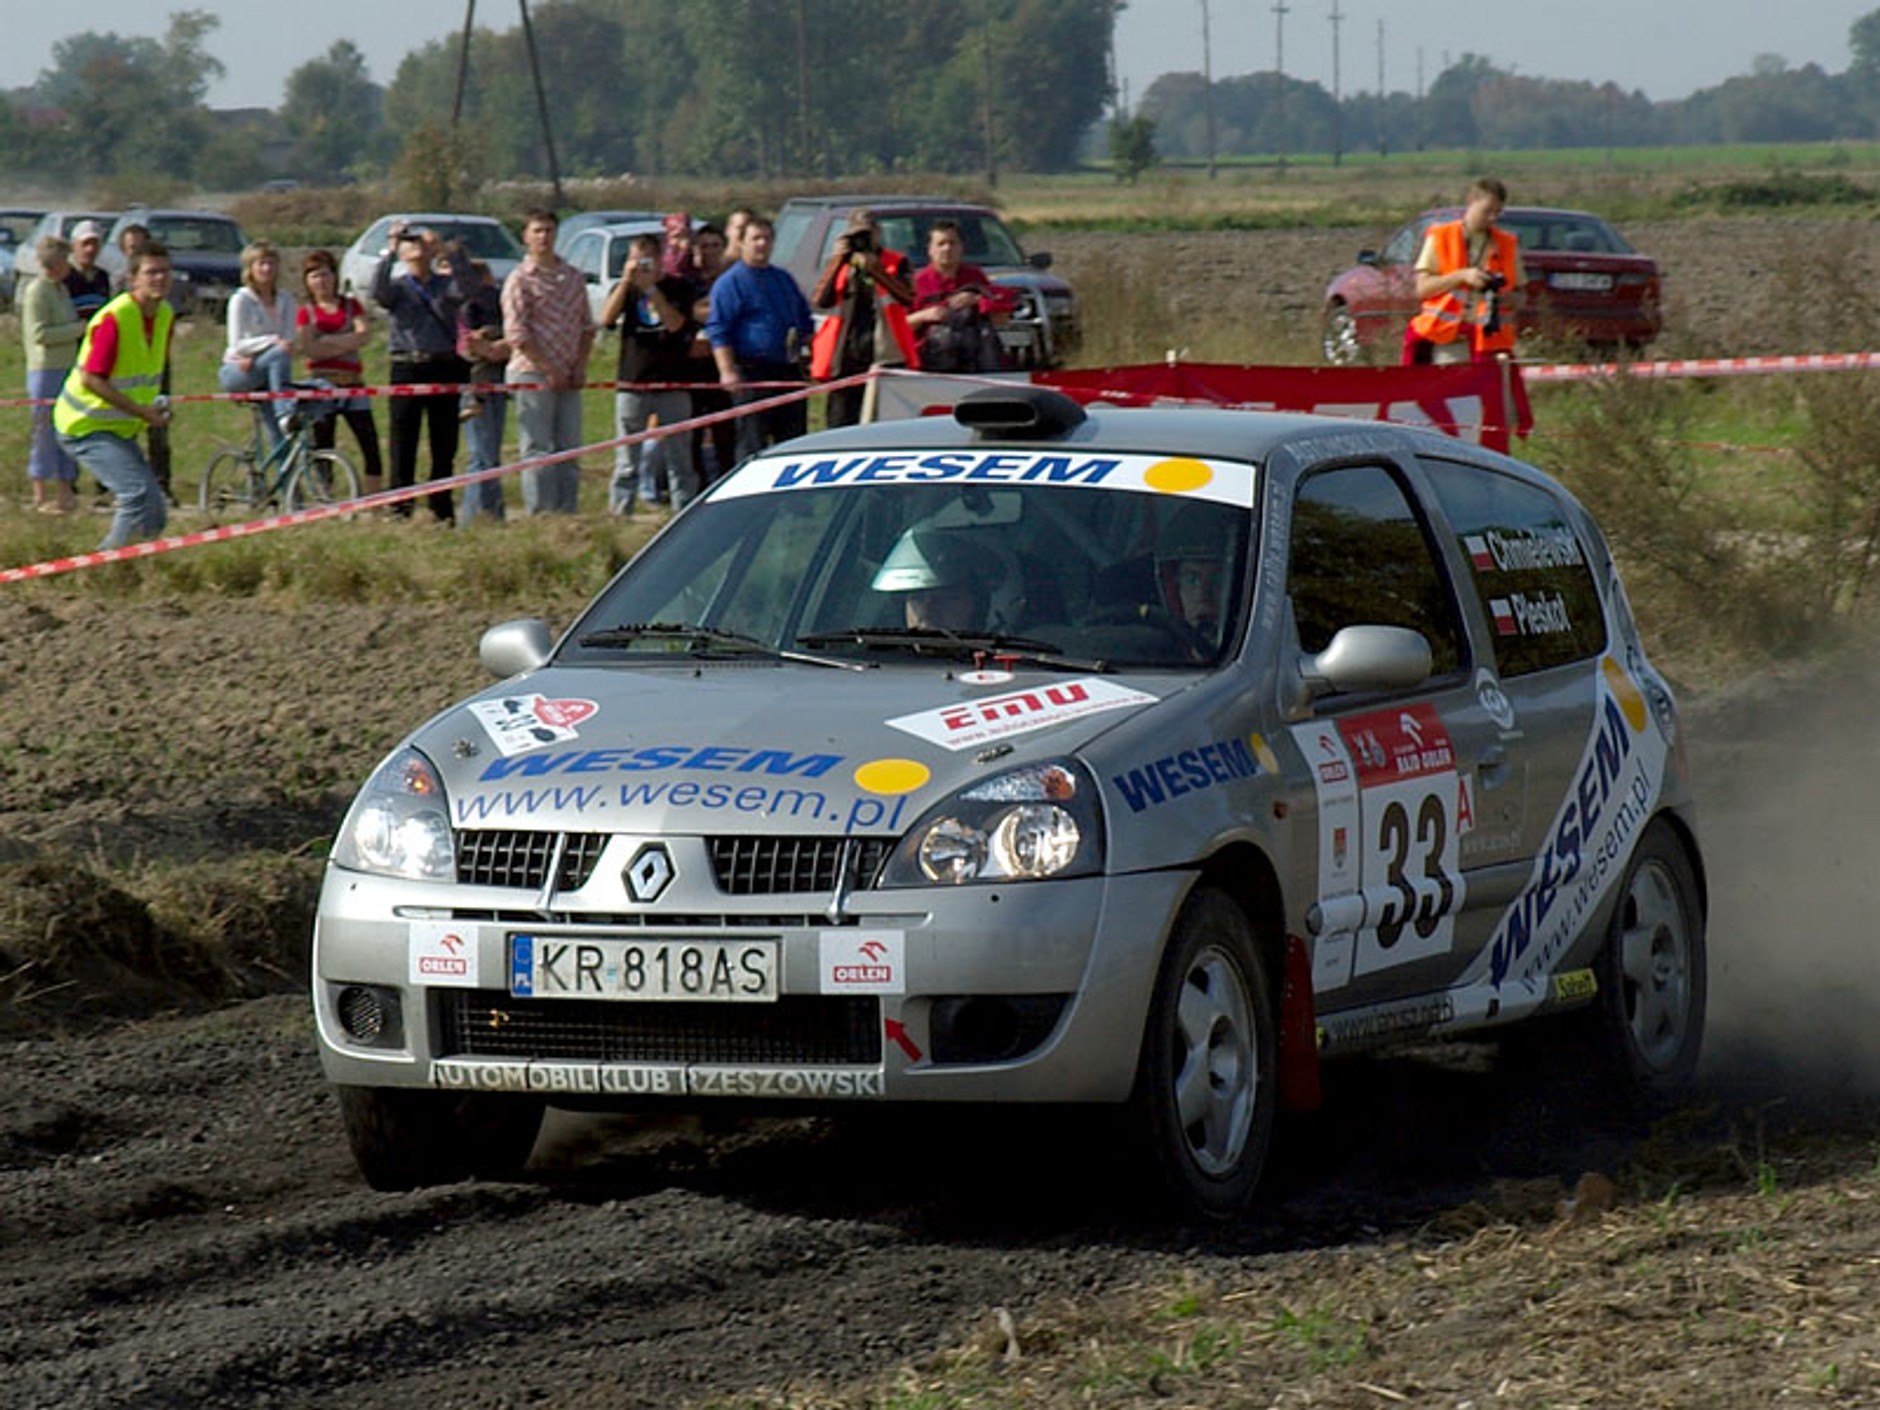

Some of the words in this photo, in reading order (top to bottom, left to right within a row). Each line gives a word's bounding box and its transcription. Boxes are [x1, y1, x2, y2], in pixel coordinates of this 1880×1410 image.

[772, 454, 1122, 489] WESEM
[478, 745, 847, 783] WESEM
[1112, 737, 1258, 814] WESEM
[456, 782, 908, 835] www.wesem.pl
[1455, 778, 1473, 835] A
[1491, 696, 1630, 991] WESEM
[1376, 793, 1454, 949] 33
[1521, 760, 1653, 996] www.wesem.pl
[420, 957, 466, 974] ORLEN
[541, 945, 604, 992] KR
[625, 946, 767, 994] 818AS
[834, 964, 892, 983] ORLEN
